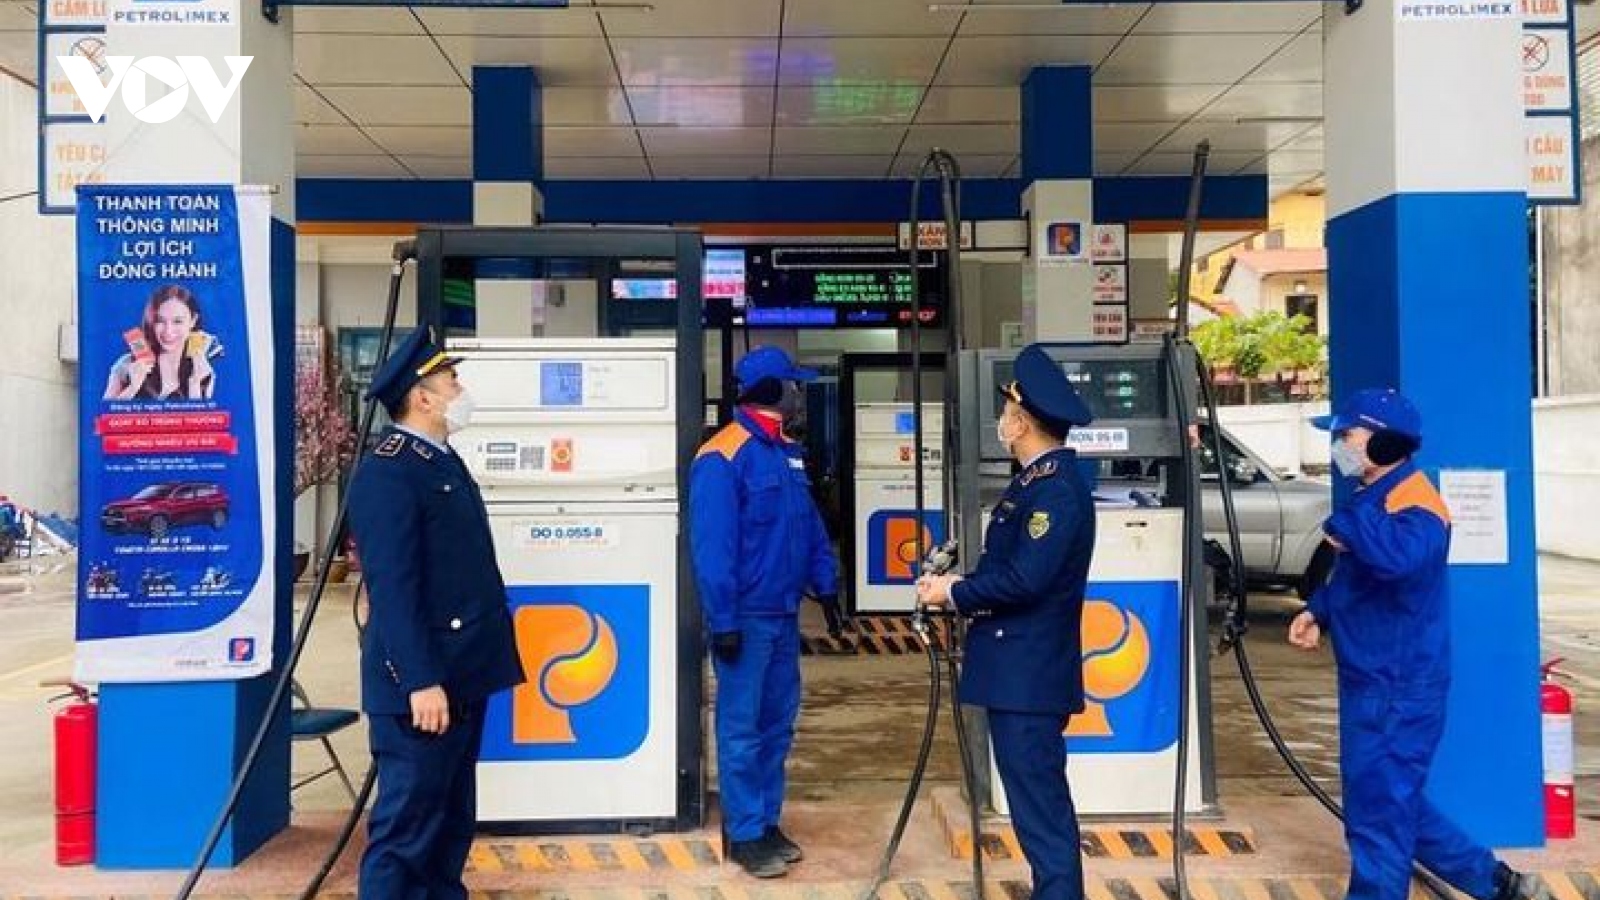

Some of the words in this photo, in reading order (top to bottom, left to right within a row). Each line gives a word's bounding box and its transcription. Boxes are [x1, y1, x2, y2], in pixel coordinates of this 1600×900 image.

[114, 11, 232, 24] PETROLIMEX
[1402, 4, 1512, 17] PETROLIMEX
[95, 195, 162, 211] THANH
[166, 193, 220, 211] TOÁN
[96, 215, 166, 235] THÔNG
[171, 218, 220, 234] MINH
[123, 240, 156, 259] LỢI
[161, 237, 193, 256] ÍCH
[99, 259, 158, 280] ĐỒNG
[162, 260, 218, 279] HÀNH
